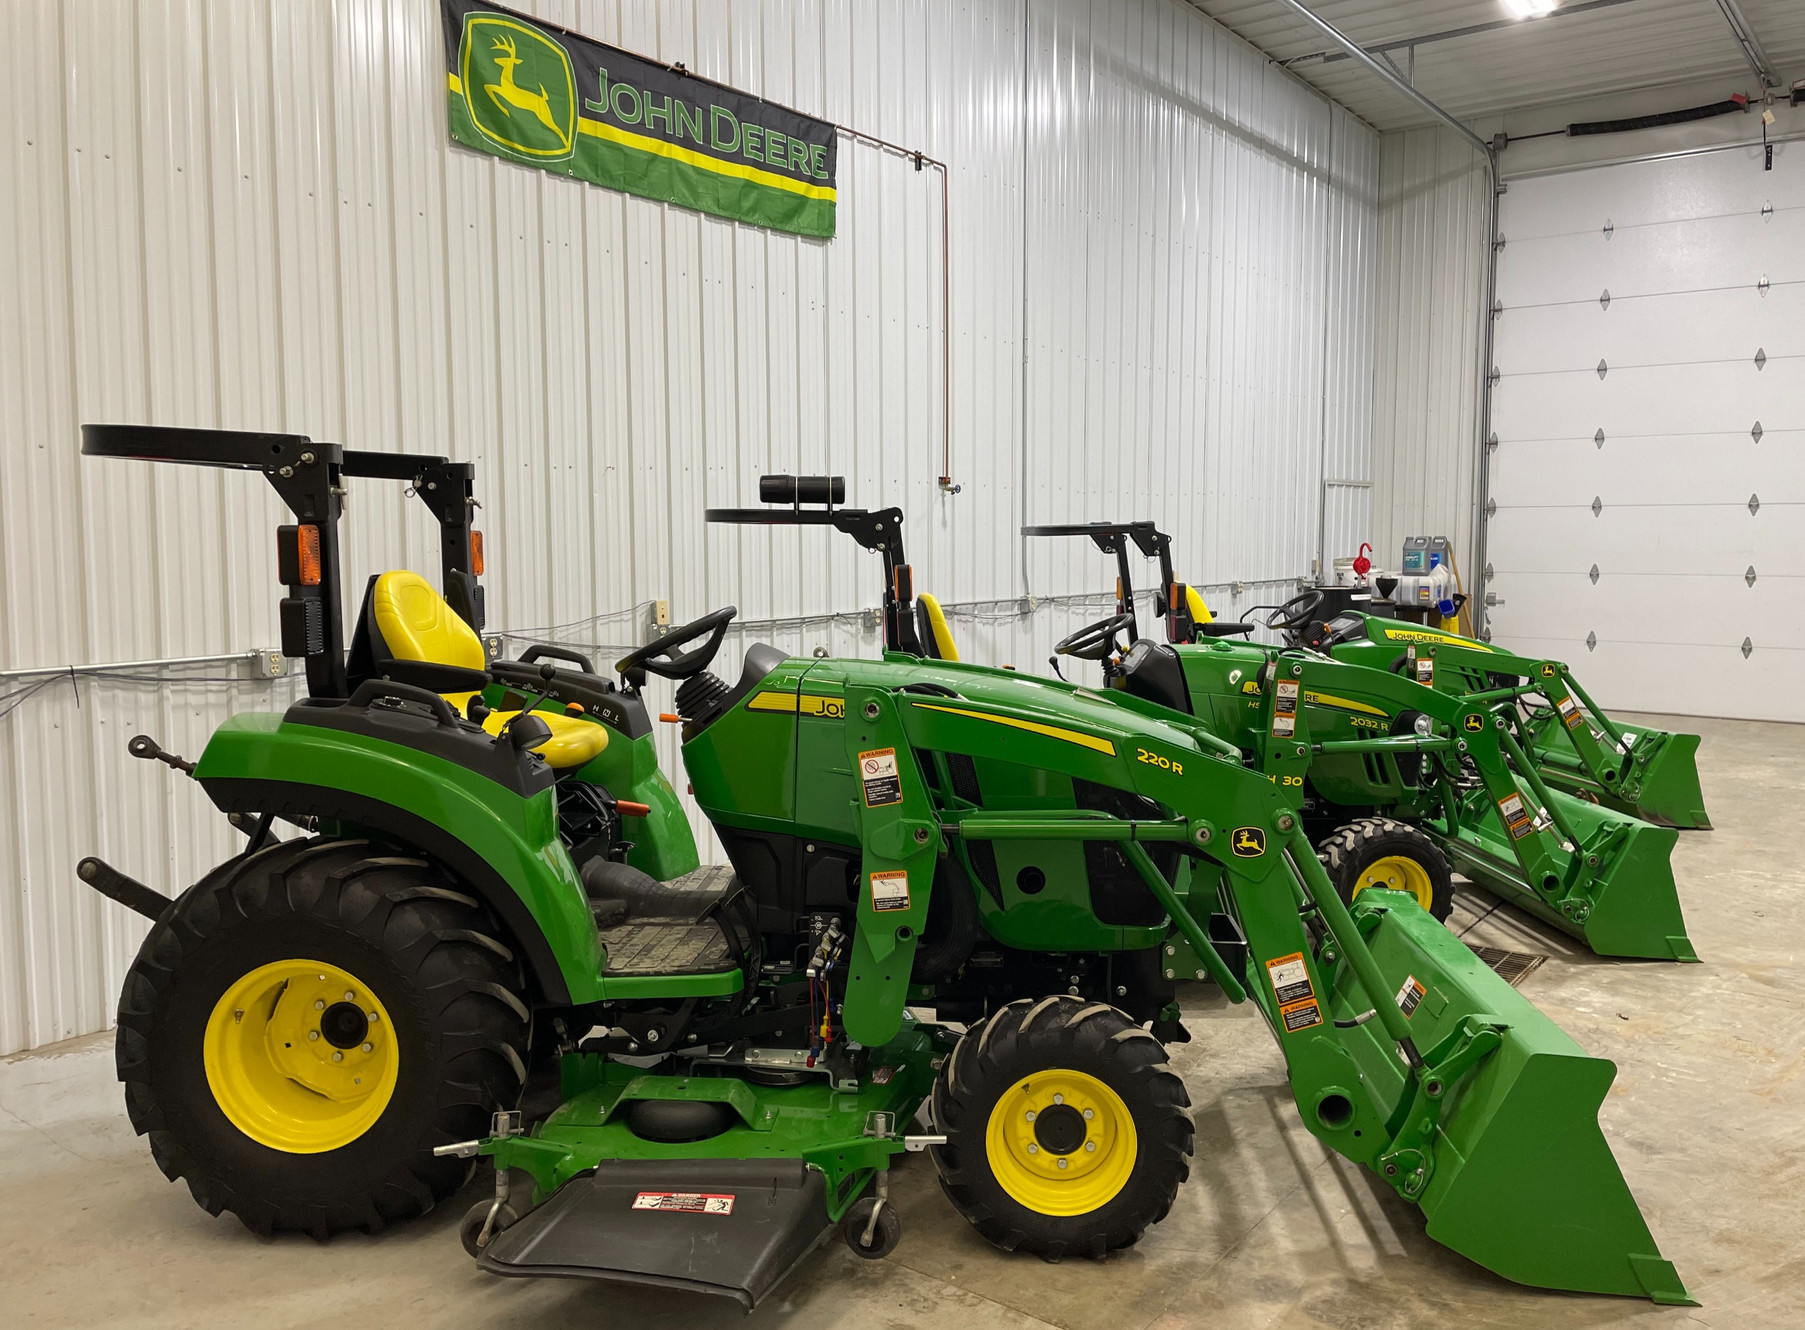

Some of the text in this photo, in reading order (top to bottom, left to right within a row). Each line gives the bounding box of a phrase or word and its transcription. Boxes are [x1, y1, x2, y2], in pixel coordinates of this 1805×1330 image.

[585, 68, 829, 179] JOHN DEERE
[1392, 632, 1444, 642] JOHN DEERE
[1350, 716, 1389, 731] 2032 R
[866, 748, 894, 758] WARNING
[1137, 748, 1183, 775] 220 R
[1282, 776, 1303, 787] 30
[877, 871, 906, 879] WARNING
[1276, 955, 1299, 965] WARNING
[1290, 1001, 1314, 1010] WARNING
